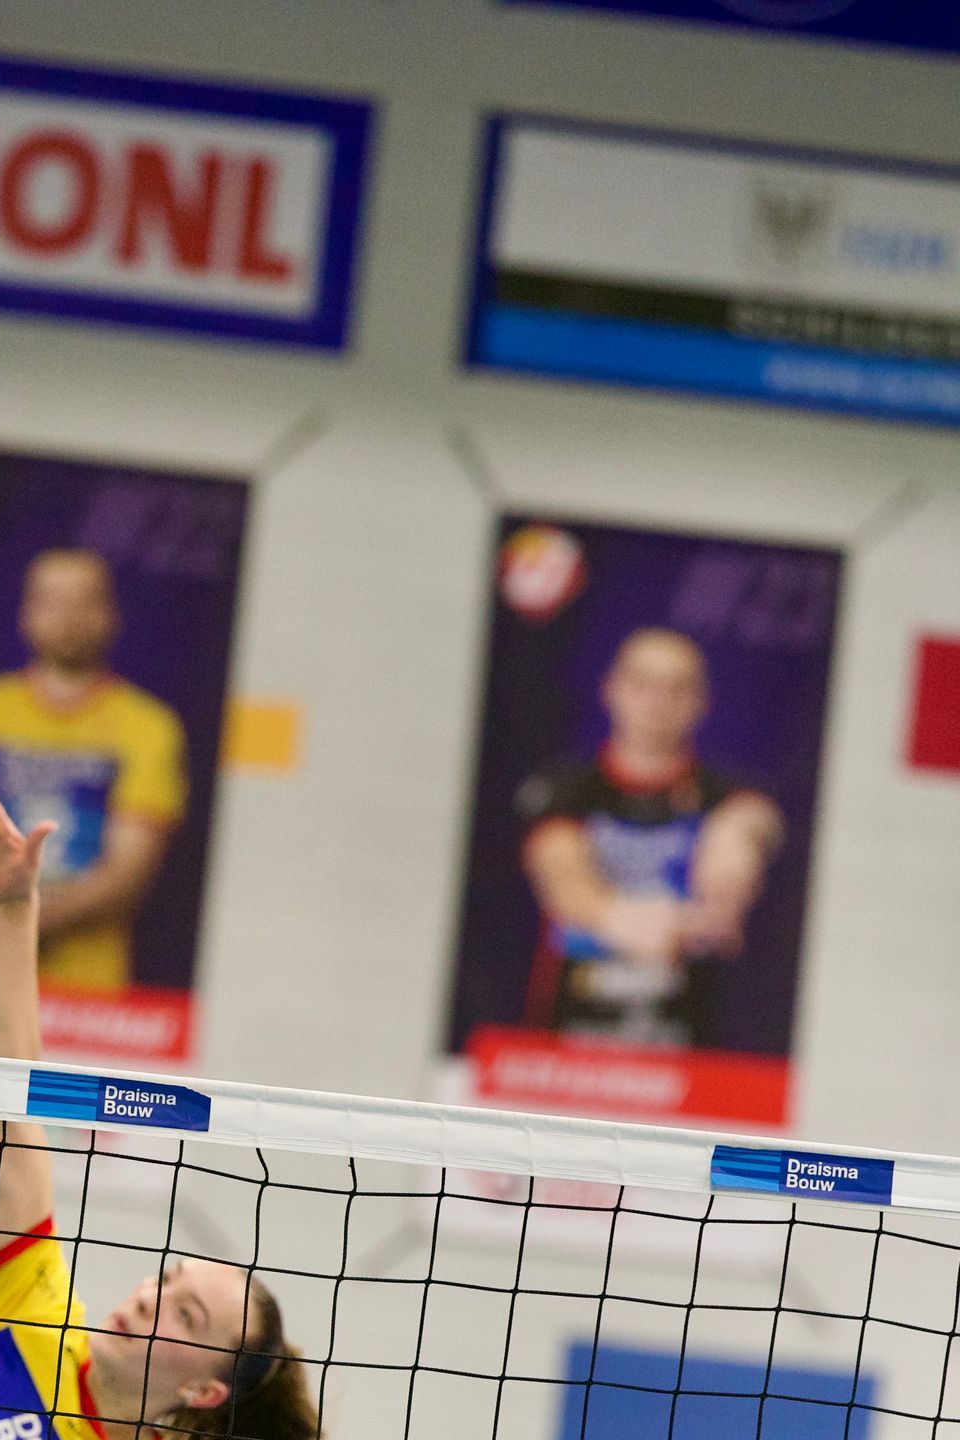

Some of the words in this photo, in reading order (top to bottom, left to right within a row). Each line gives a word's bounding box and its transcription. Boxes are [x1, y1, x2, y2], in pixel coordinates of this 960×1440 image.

[105, 1085, 177, 1105] Draisma
[103, 1099, 153, 1118] Bouw
[787, 1158, 858, 1179] Draisma
[786, 1173, 835, 1192] Bouw
